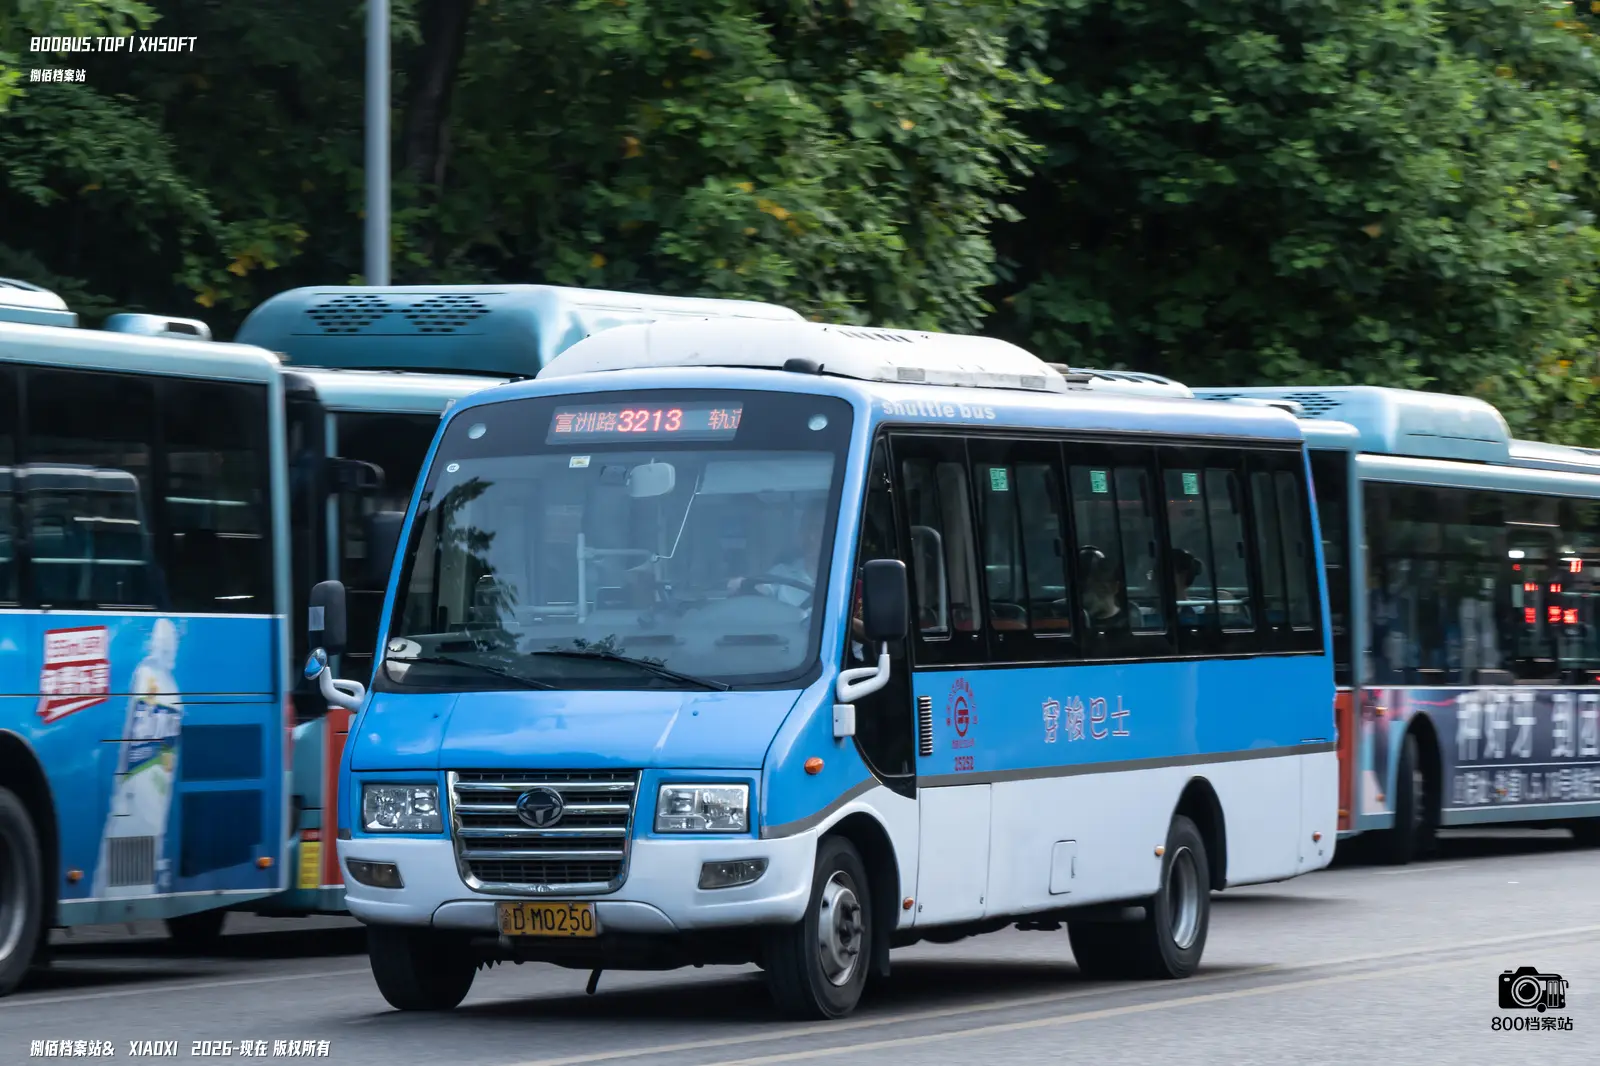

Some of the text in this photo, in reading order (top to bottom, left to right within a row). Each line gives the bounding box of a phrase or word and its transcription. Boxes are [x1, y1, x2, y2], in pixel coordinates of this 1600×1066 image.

[555, 412, 618, 433] 富洲路
[616, 409, 683, 432] 3213
[958, 403, 996, 419] bus
[1041, 695, 1130, 743] 穿梭巴士
